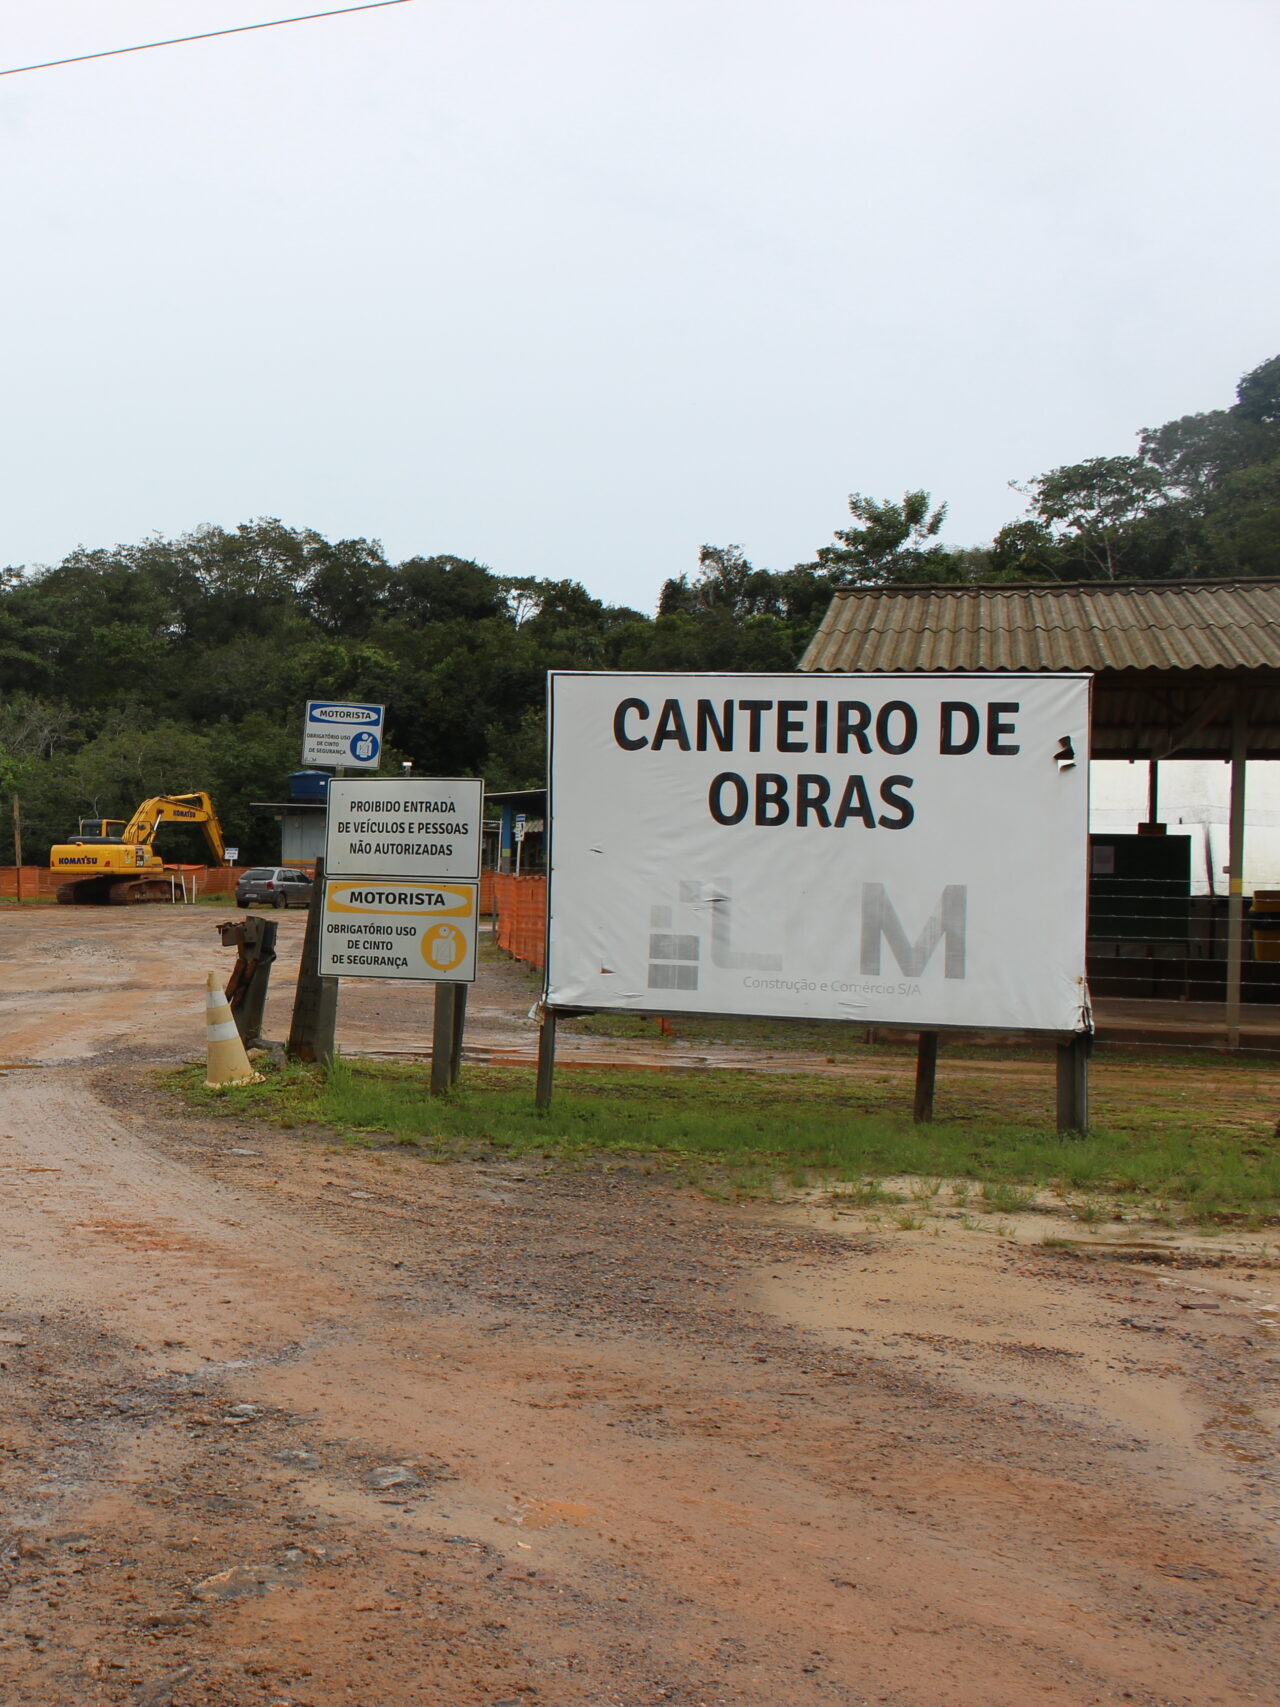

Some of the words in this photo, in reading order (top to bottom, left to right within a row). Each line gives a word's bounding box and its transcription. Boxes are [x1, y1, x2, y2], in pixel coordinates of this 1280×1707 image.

[320, 710, 372, 720] MOTORISTA
[613, 697, 918, 755] CANTEIRO
[939, 701, 1020, 756] DE
[350, 801, 401, 812] PROIBIDO
[404, 801, 456, 813] ENTRADA
[708, 771, 915, 830] OBRAS
[173, 810, 196, 818] KOMATSU
[338, 822, 351, 833] DE
[353, 818, 405, 834] VEÍCULOS
[408, 822, 415, 834] E
[418, 823, 469, 834] PESSOAS
[350, 840, 371, 854] NÃO
[374, 844, 453, 856] AUTORIZADAS
[58, 856, 98, 864] KOMATSU
[350, 892, 446, 906] MOTORISTA
[327, 924, 392, 936] OBRIGATÓRIO
[396, 926, 416, 936] USO
[347, 940, 360, 949] DE
[362, 941, 392, 950] CINTO
[332, 954, 344, 964] DE
[347, 955, 408, 968] SEGURANÇA
[742, 976, 817, 994] Construção
[820, 982, 828, 992] e
[830, 980, 896, 994] Comércio
[897, 983, 921, 996] S/A
